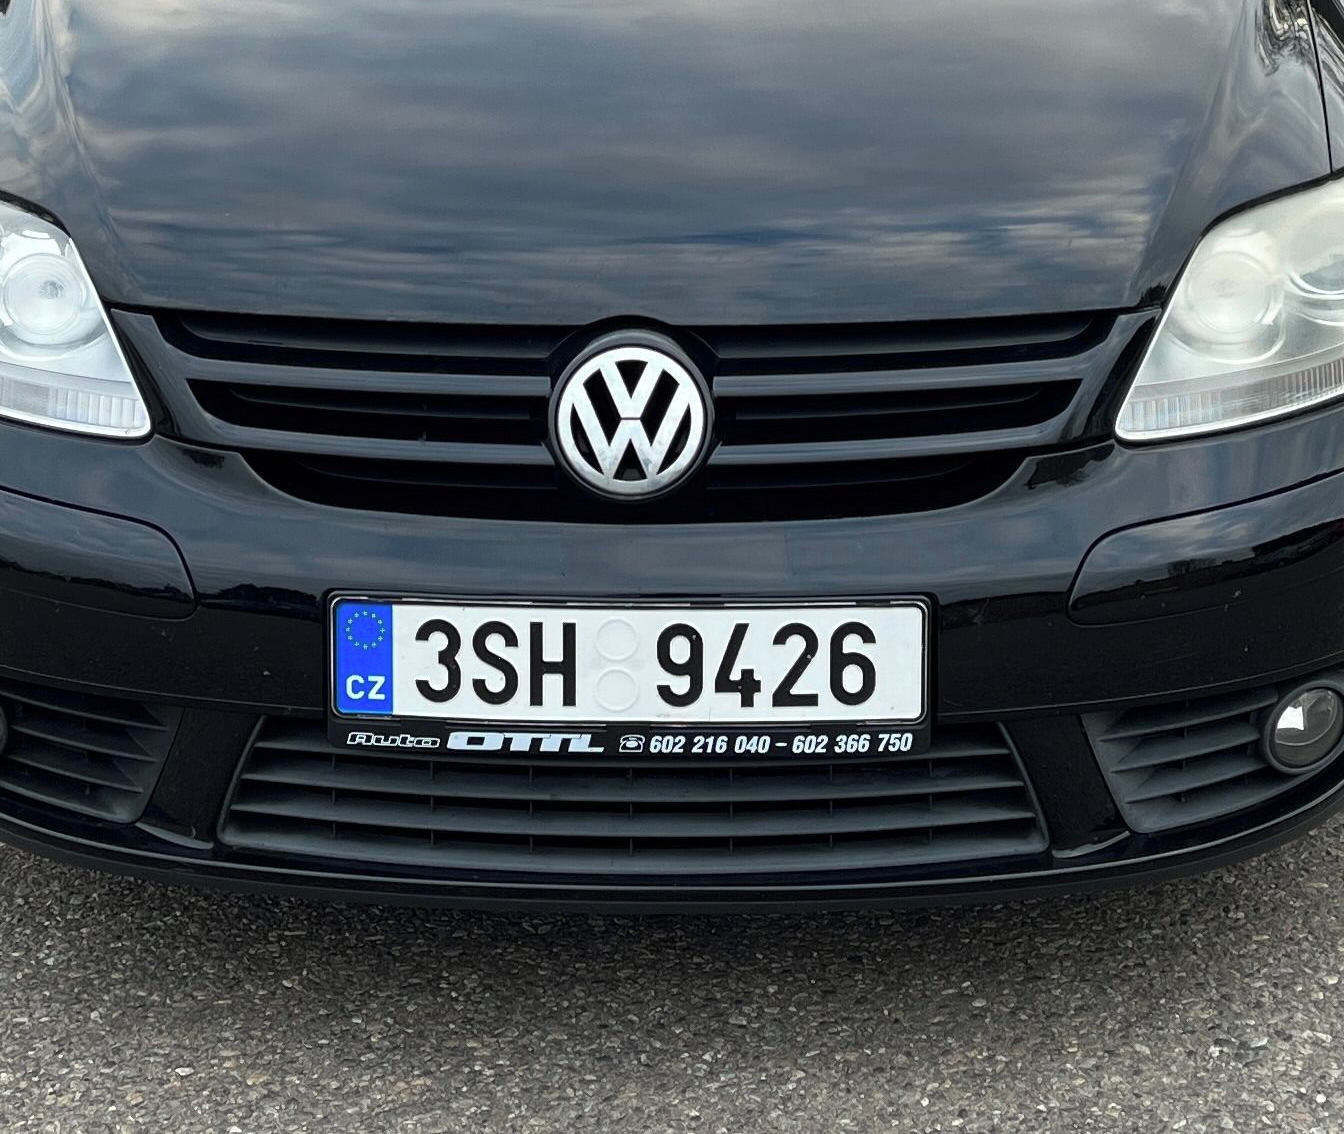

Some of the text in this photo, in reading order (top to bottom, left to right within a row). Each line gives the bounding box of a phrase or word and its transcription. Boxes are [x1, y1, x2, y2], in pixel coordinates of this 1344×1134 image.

[557, 346, 704, 495] VW
[346, 674, 386, 700] CZ
[414, 618, 878, 709] 3SH 9426
[346, 731, 441, 748] Auto
[446, 731, 605, 753] OTTL
[649, 735, 686, 754] 602
[691, 735, 729, 754] 216
[734, 735, 772, 754] 040
[791, 735, 829, 754] 602
[833, 733, 871, 753] 366
[877, 732, 913, 752] 750
